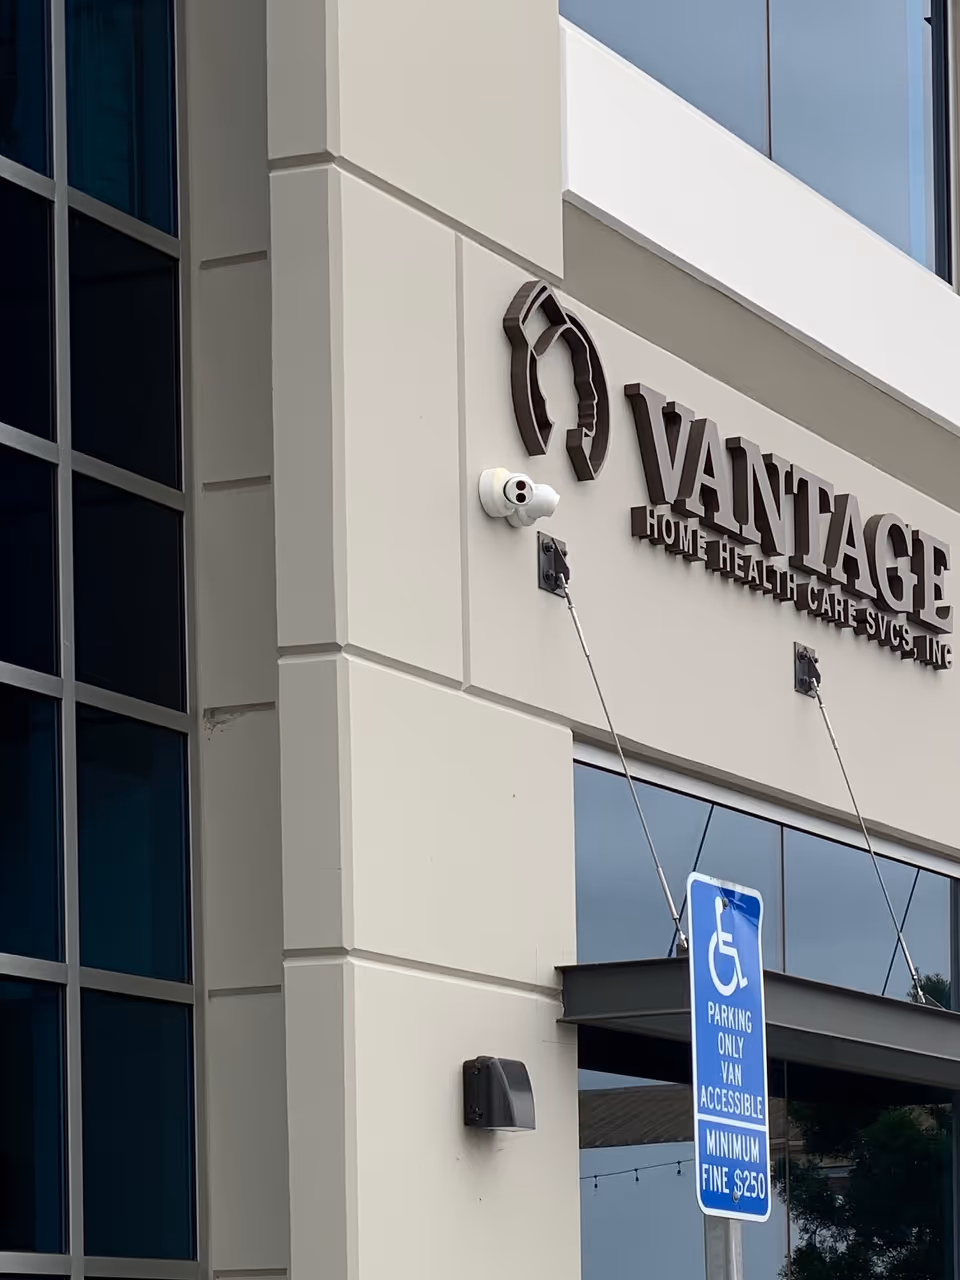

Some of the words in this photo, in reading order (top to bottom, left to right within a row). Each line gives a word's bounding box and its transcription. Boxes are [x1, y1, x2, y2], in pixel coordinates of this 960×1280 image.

[624, 383, 954, 633] VANTAGE
[631, 505, 707, 562] HOME
[705, 539, 798, 601] HEALTH
[795, 580, 857, 628] CARE
[855, 608, 918, 659] SVCS,
[913, 634, 953, 670] INC
[708, 1000, 752, 1034] PARKING
[718, 1031, 744, 1060] ONLY
[721, 1060, 742, 1088] VAN
[700, 1085, 763, 1120] ACCESSIBLE
[706, 1128, 760, 1164] MINIMUM
[702, 1164, 729, 1194] FINE
[733, 1168, 766, 1200] $250
